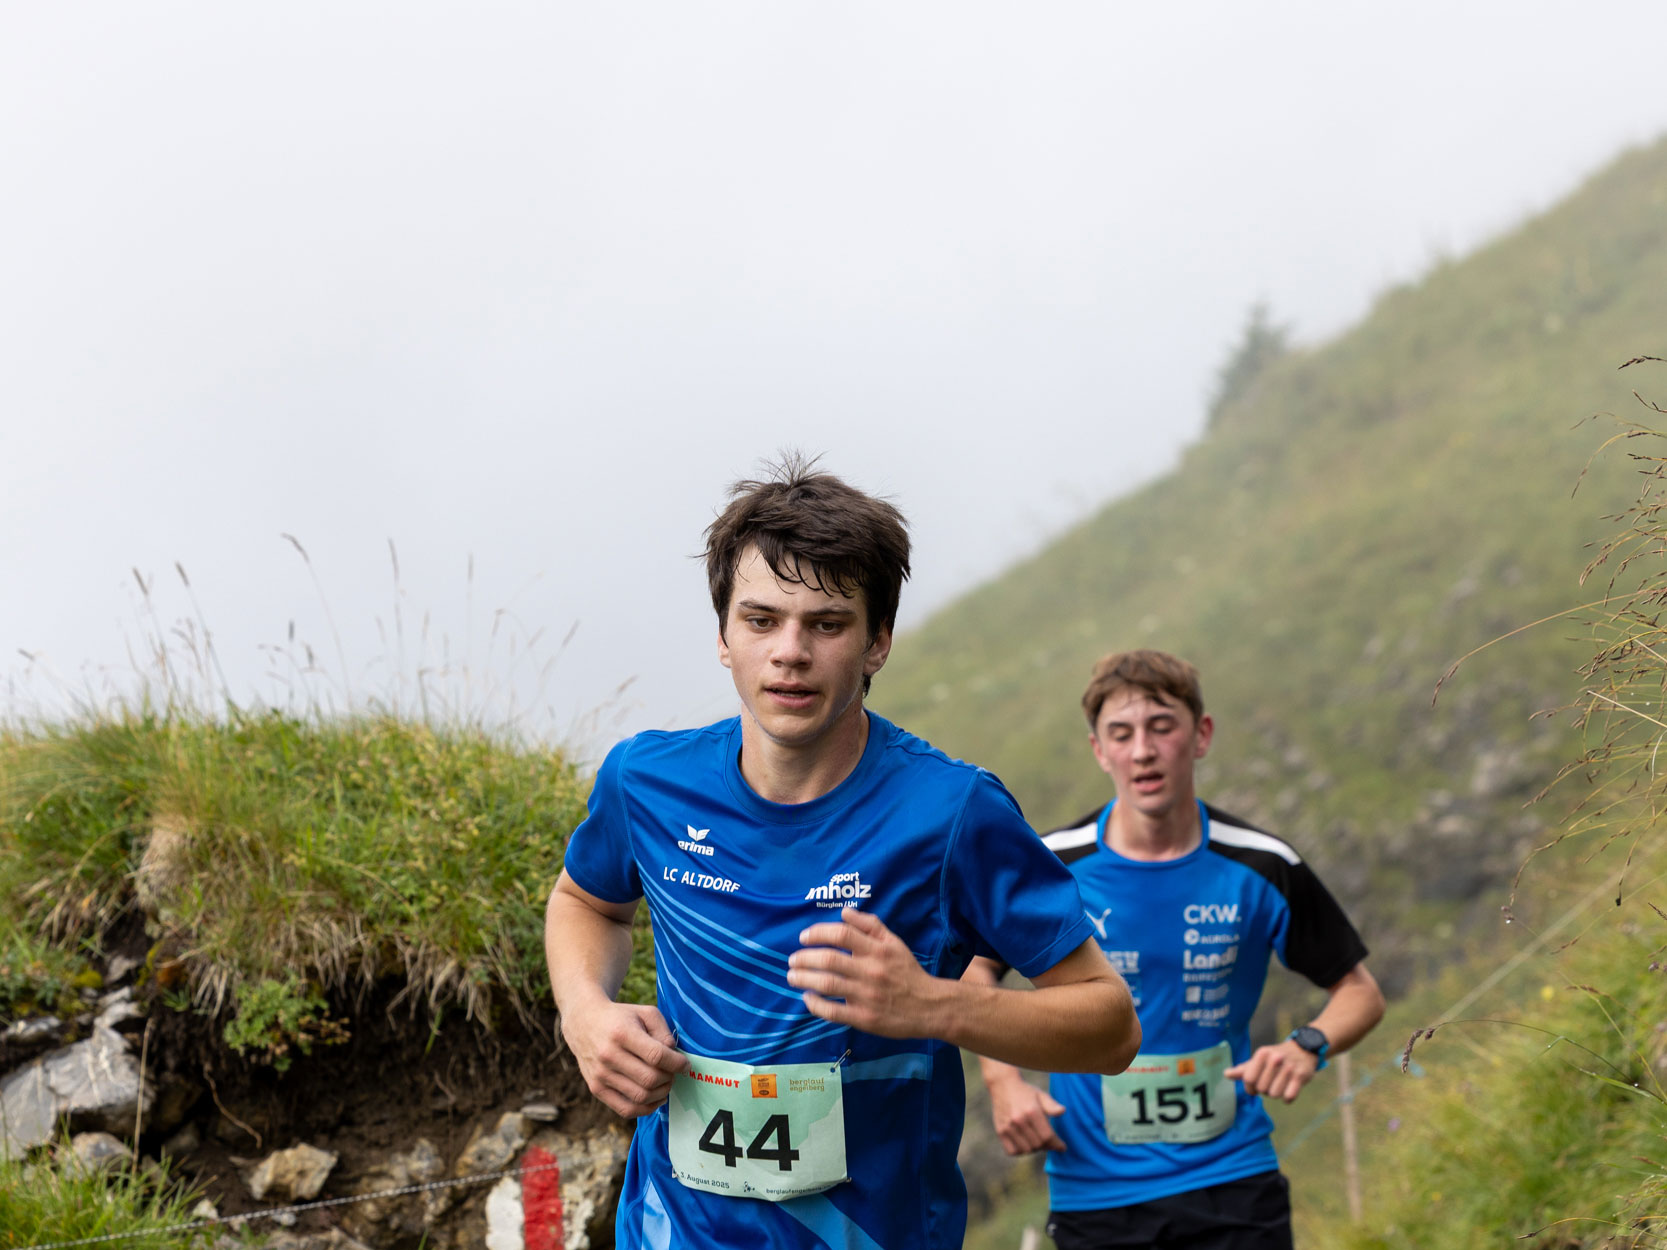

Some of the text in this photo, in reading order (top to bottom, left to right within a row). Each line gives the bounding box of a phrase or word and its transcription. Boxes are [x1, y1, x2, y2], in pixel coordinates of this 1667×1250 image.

[677, 840, 715, 857] erima
[663, 866, 741, 893] LC ALTDORF
[830, 871, 860, 885] sport
[816, 901, 843, 909] Bürglen
[689, 1070, 740, 1089] MAMMUT
[789, 1077, 824, 1087] berglauf
[789, 1085, 824, 1093] engelberg
[1131, 1082, 1215, 1126] 151
[698, 1108, 800, 1172] 44
[687, 1174, 710, 1185] August
[711, 1180, 730, 1189] 2025
